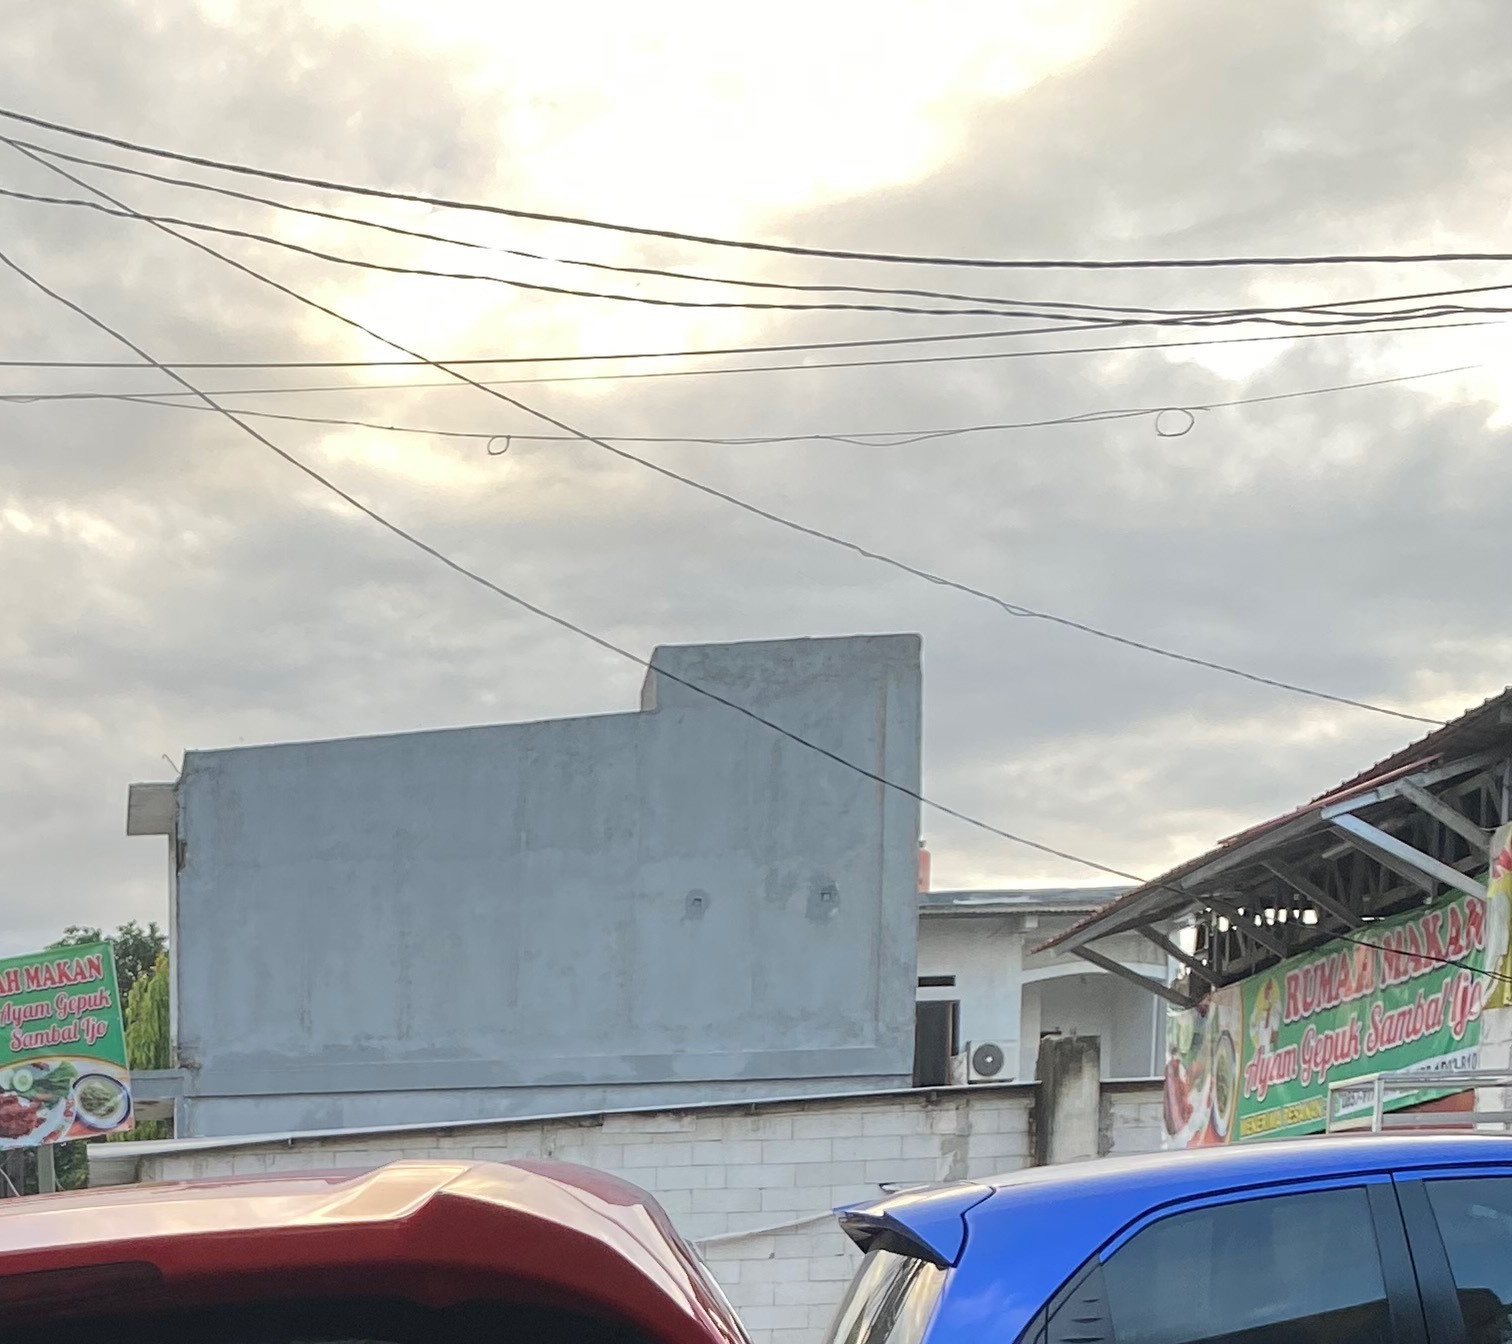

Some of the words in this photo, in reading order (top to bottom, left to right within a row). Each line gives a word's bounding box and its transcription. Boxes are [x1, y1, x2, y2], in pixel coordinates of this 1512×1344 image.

[24, 954, 102, 989] MAKAN
[1284, 942, 1375, 1023] RUMAH
[1381, 898, 1487, 988] MAKAN
[55, 988, 112, 1020] Gepuk
[10, 1023, 79, 1050] Sambal
[82, 1017, 108, 1044] Ijo
[1245, 1045, 1298, 1101] Ayam
[1301, 1010, 1361, 1086] Gepuk
[1366, 986, 1445, 1056] Sambal
